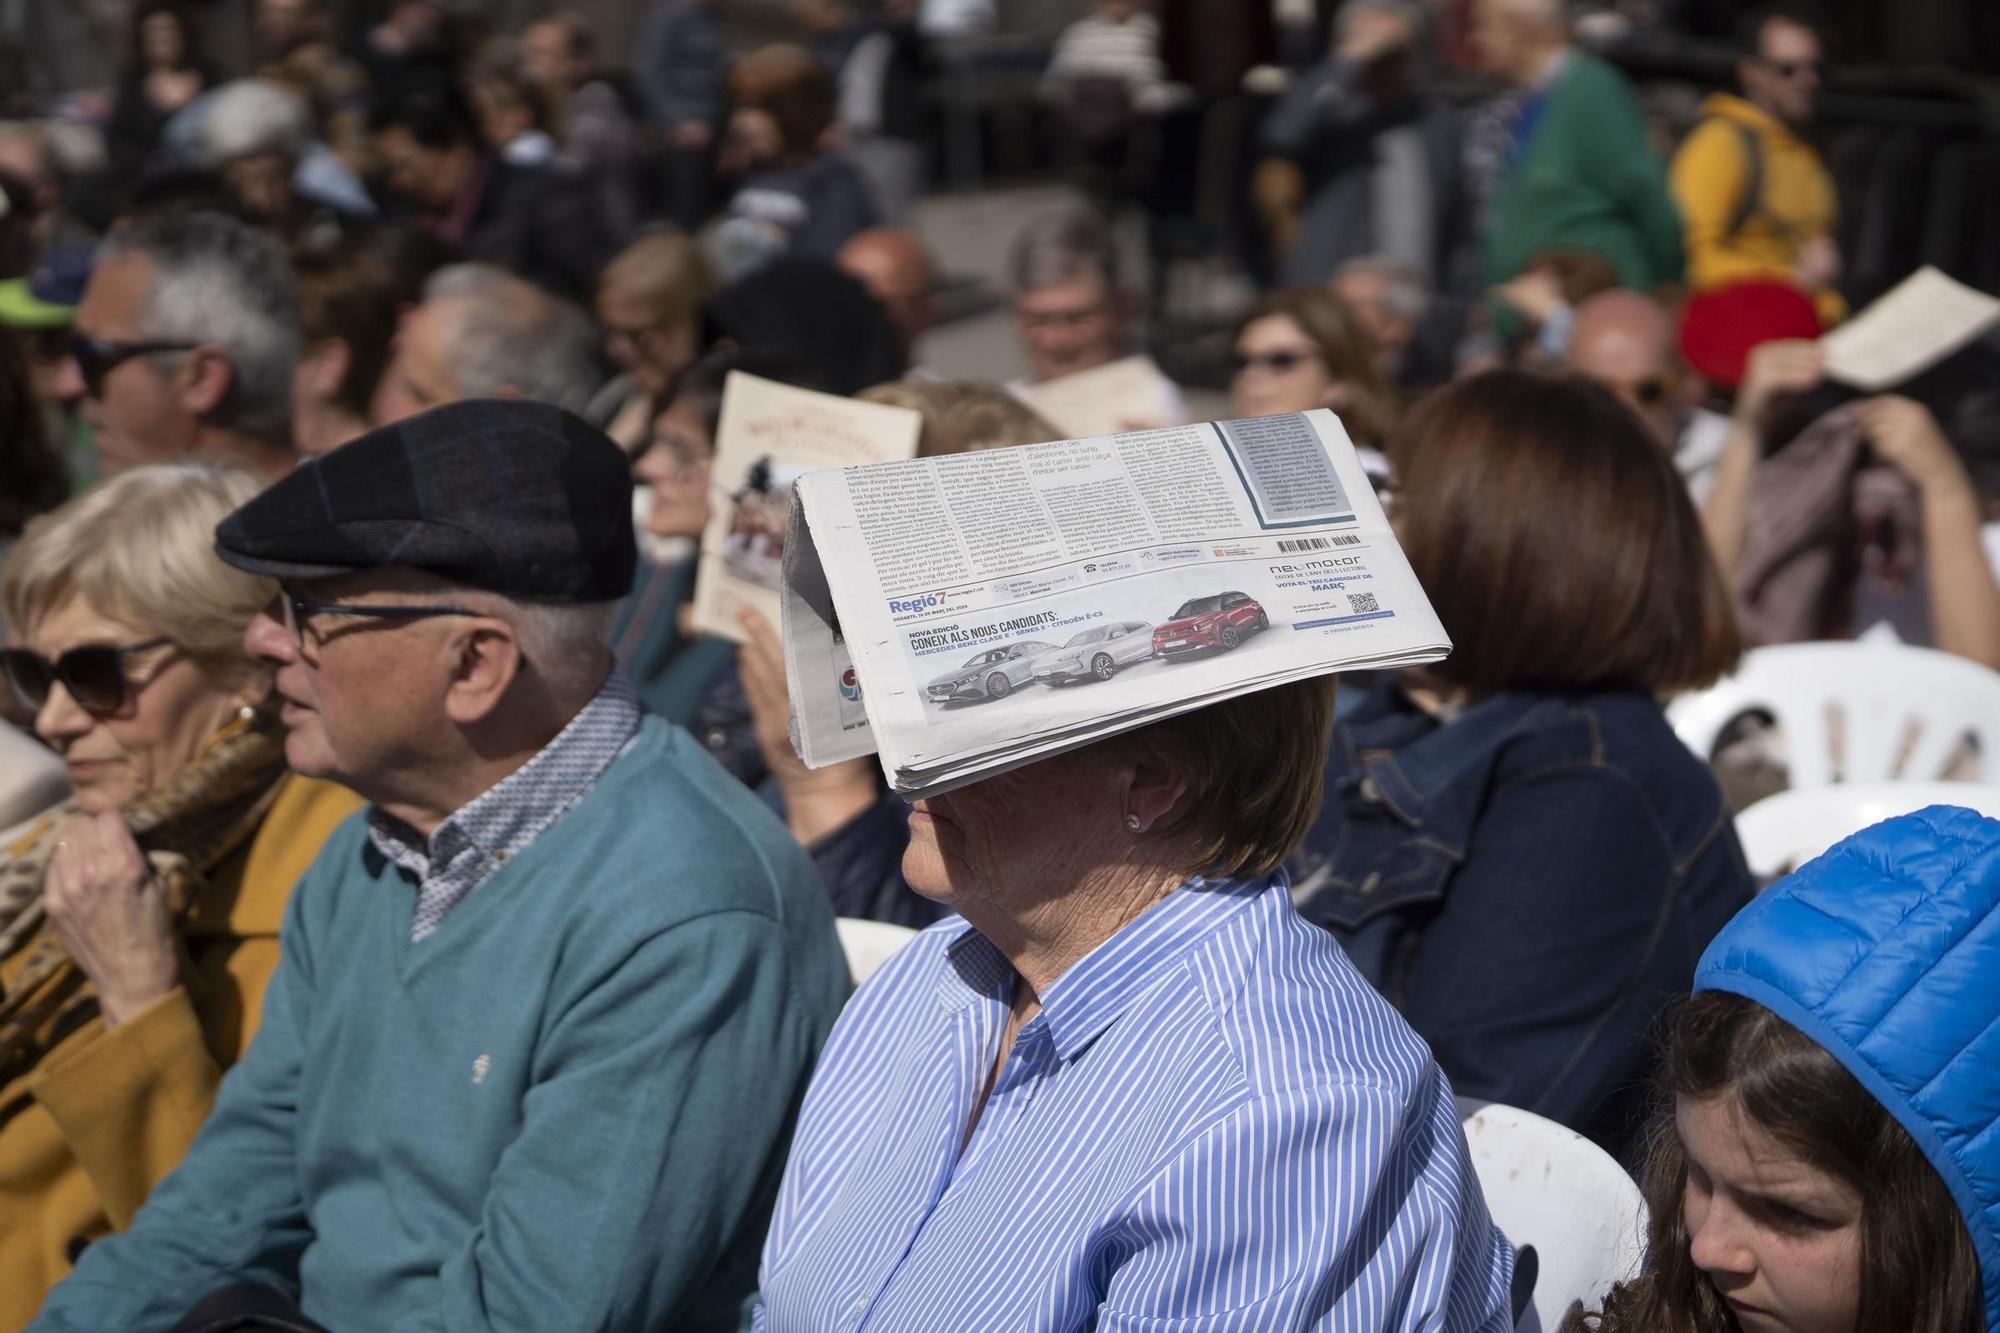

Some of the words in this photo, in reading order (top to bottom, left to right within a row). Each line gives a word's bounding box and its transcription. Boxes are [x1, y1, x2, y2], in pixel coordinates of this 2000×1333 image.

[1311, 582, 1345, 592] MARÇ
[1323, 575, 1361, 583] CANDIDAT
[889, 591, 946, 614] Regió7
[908, 628, 932, 638] NOVA
[932, 624, 959, 634] EDICIÓ
[911, 635, 949, 650] CONEIX
[950, 630, 969, 642] ALS
[971, 625, 998, 639] NOUS
[999, 611, 1059, 632] CANDIDATS:
[914, 645, 956, 657] MERCEDES
[958, 641, 978, 649] BENZ
[979, 635, 1003, 644] CLASE
[1016, 627, 1039, 636] SERES
